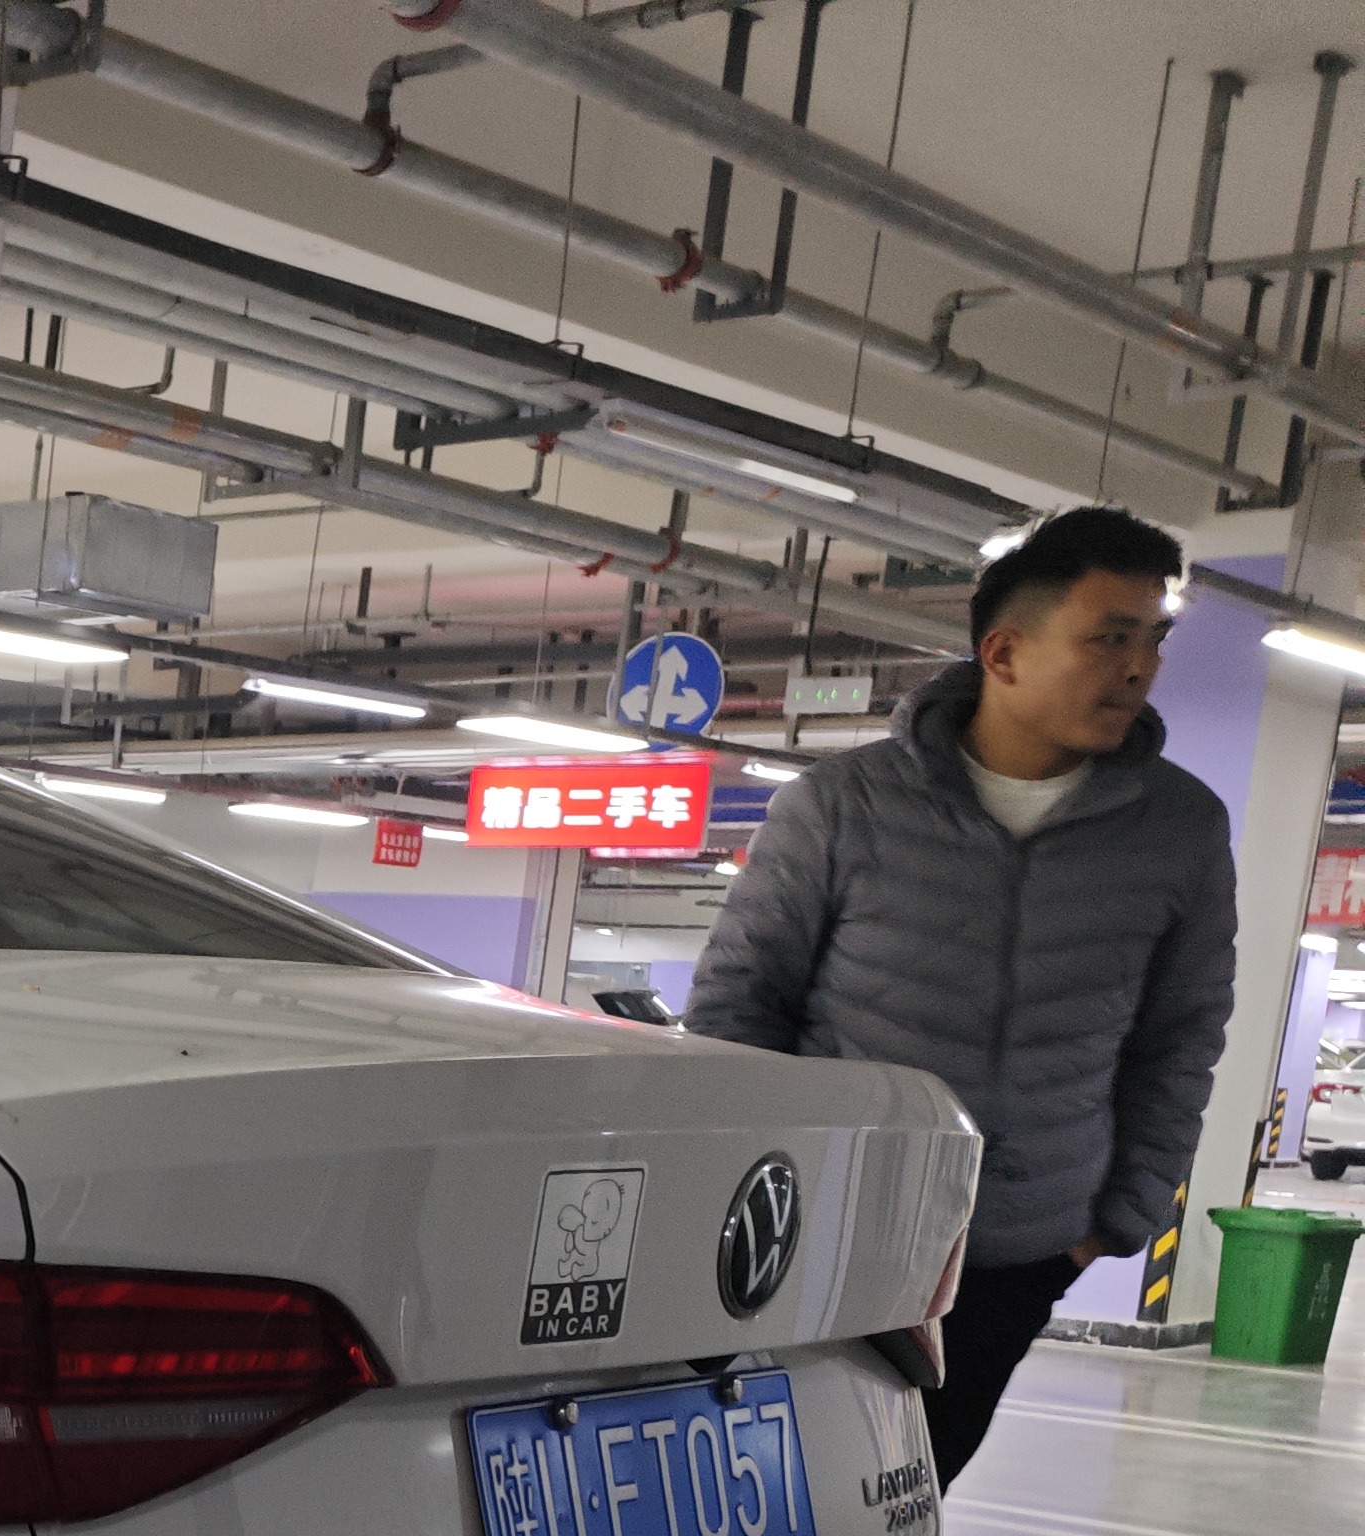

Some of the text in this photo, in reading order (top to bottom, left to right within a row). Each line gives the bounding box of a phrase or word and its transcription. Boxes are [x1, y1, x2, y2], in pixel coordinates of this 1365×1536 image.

[481, 785, 693, 829] 精品二手车
[529, 1282, 624, 1317] BABY
[536, 1314, 610, 1338] IN CAR
